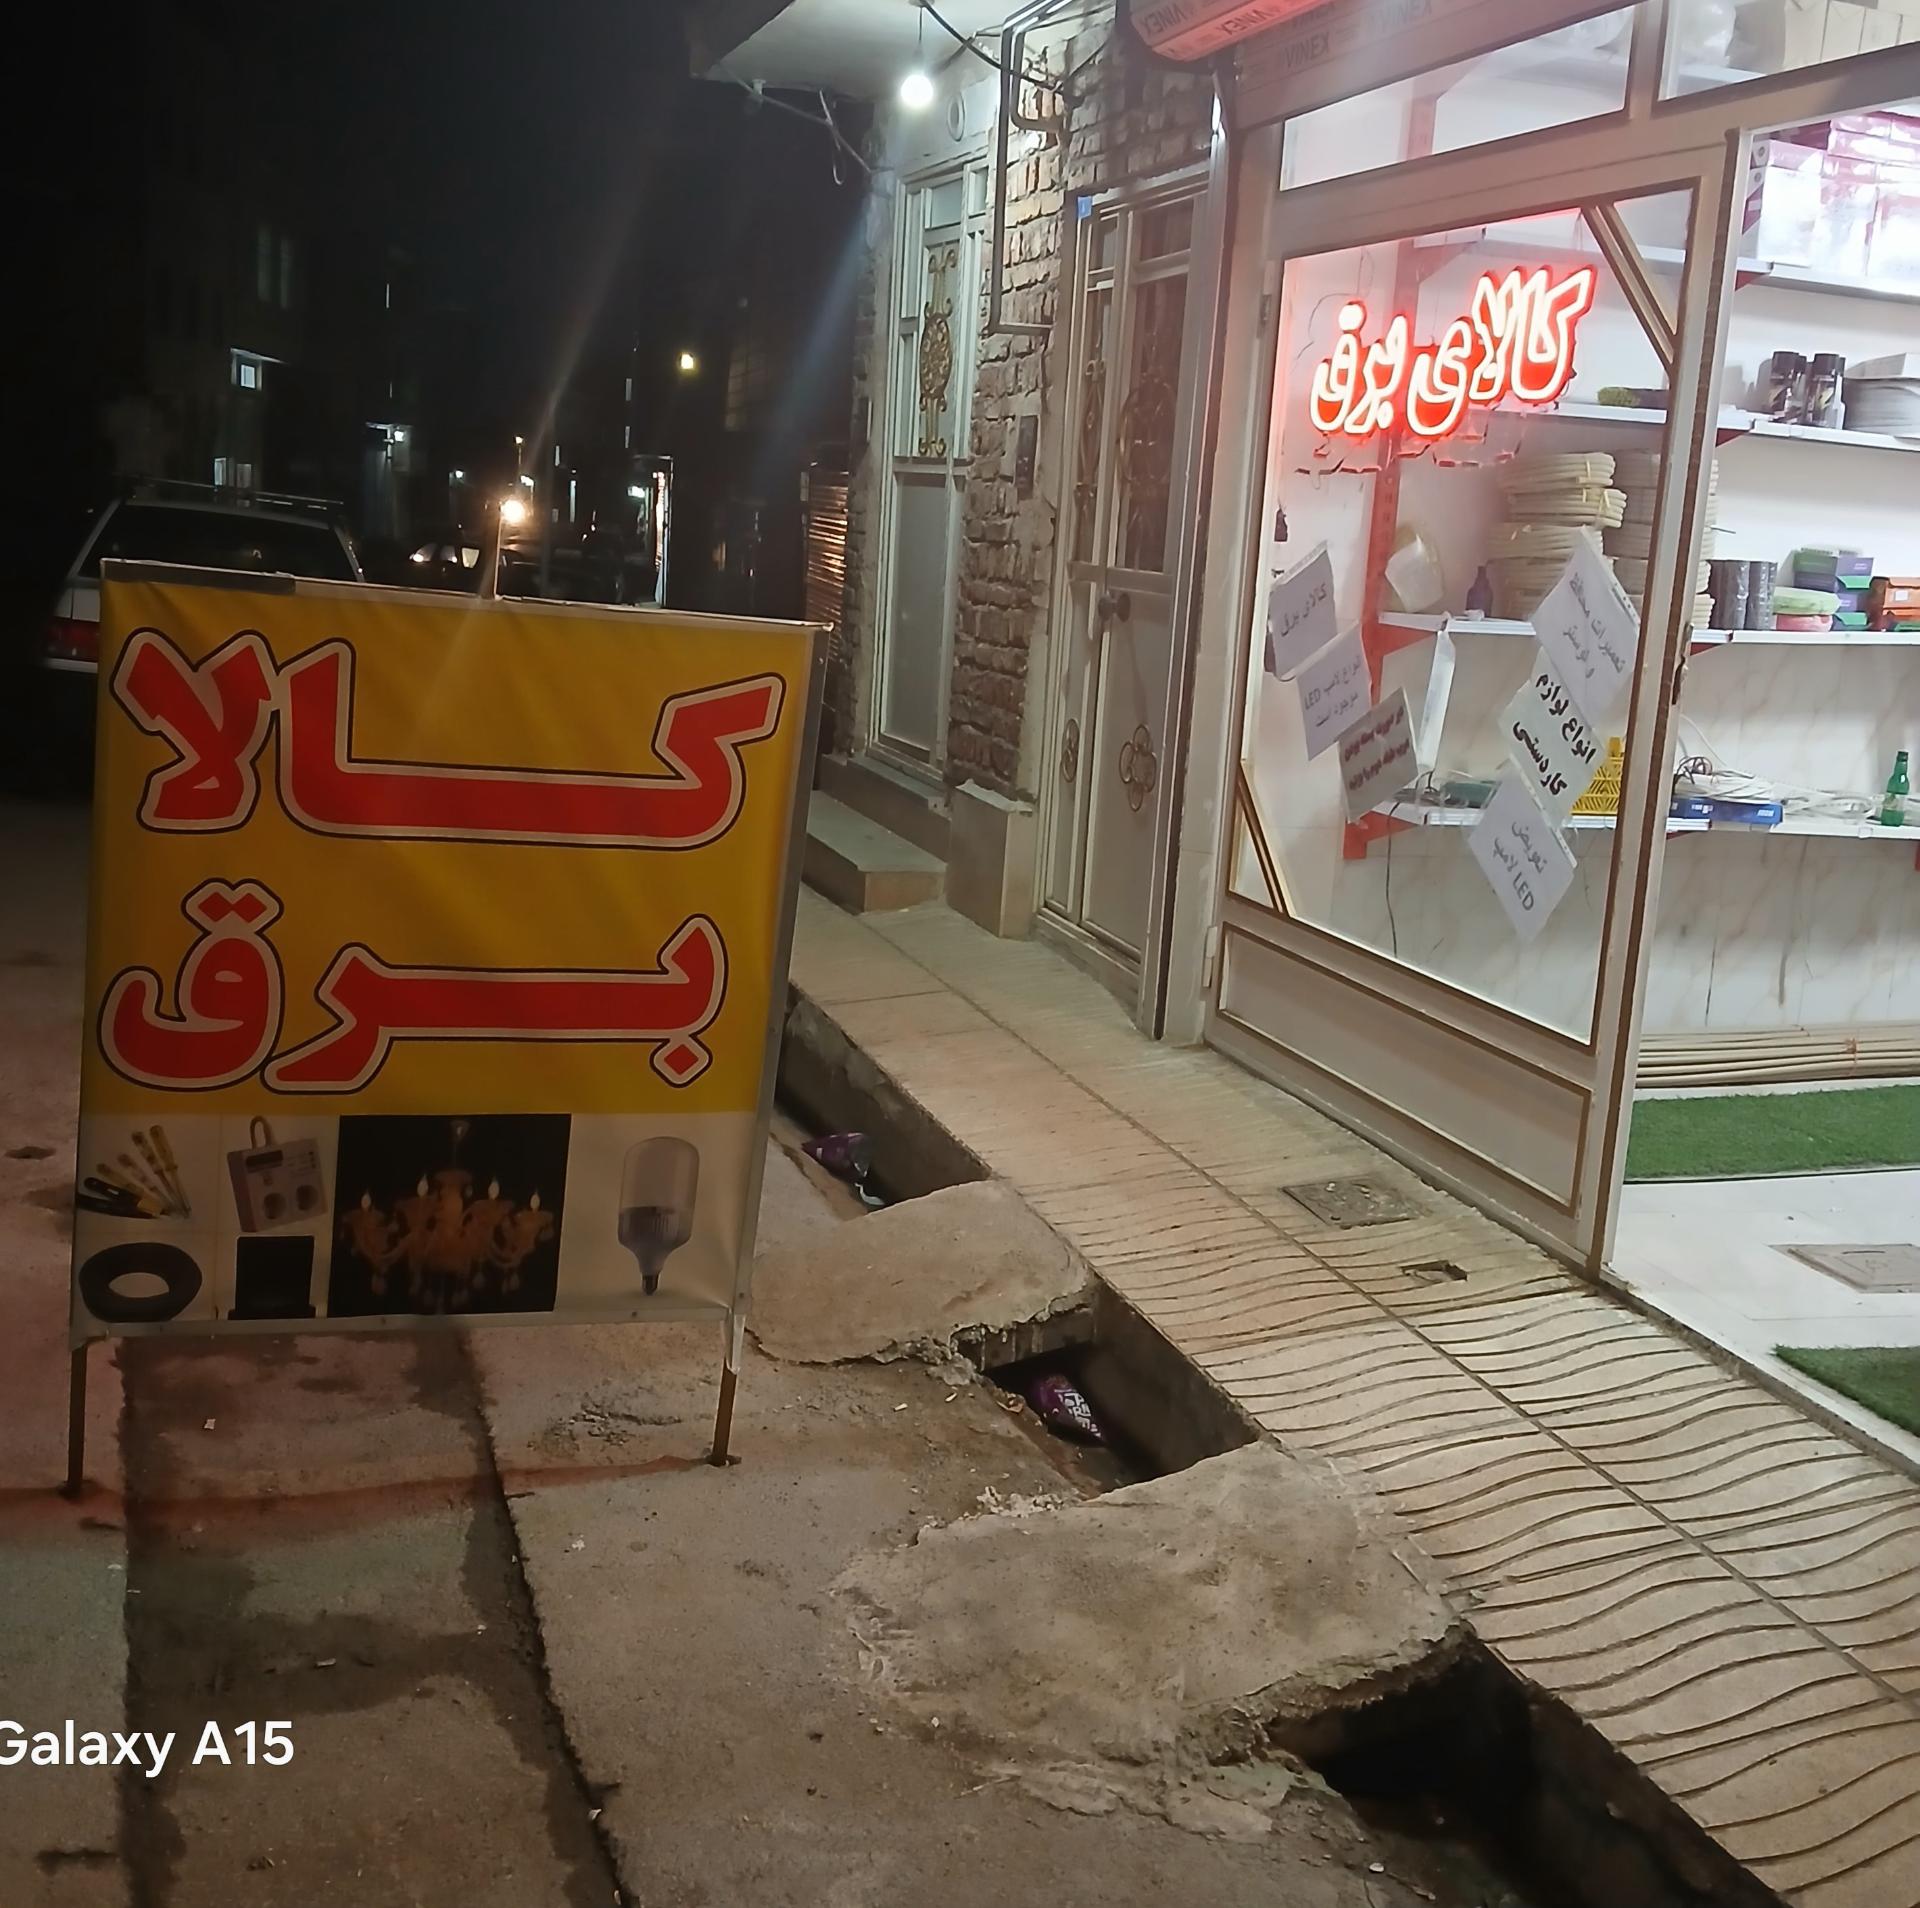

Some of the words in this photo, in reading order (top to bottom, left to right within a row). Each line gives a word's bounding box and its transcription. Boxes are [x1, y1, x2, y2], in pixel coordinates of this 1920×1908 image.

[1284, 31, 1330, 68] VINEX
[1309, 302, 1408, 437] برق
[1406, 265, 1594, 437] کالای
[1303, 687, 1321, 711] LED
[1535, 674, 1570, 716] لوازم
[110, 627, 786, 851] کالا
[1512, 721, 1568, 796] کاردستی
[1561, 717, 1597, 765] انواع
[1511, 821, 1549, 874] تعویض
[1512, 871, 1535, 911] LED
[97, 879, 728, 1094] برق
